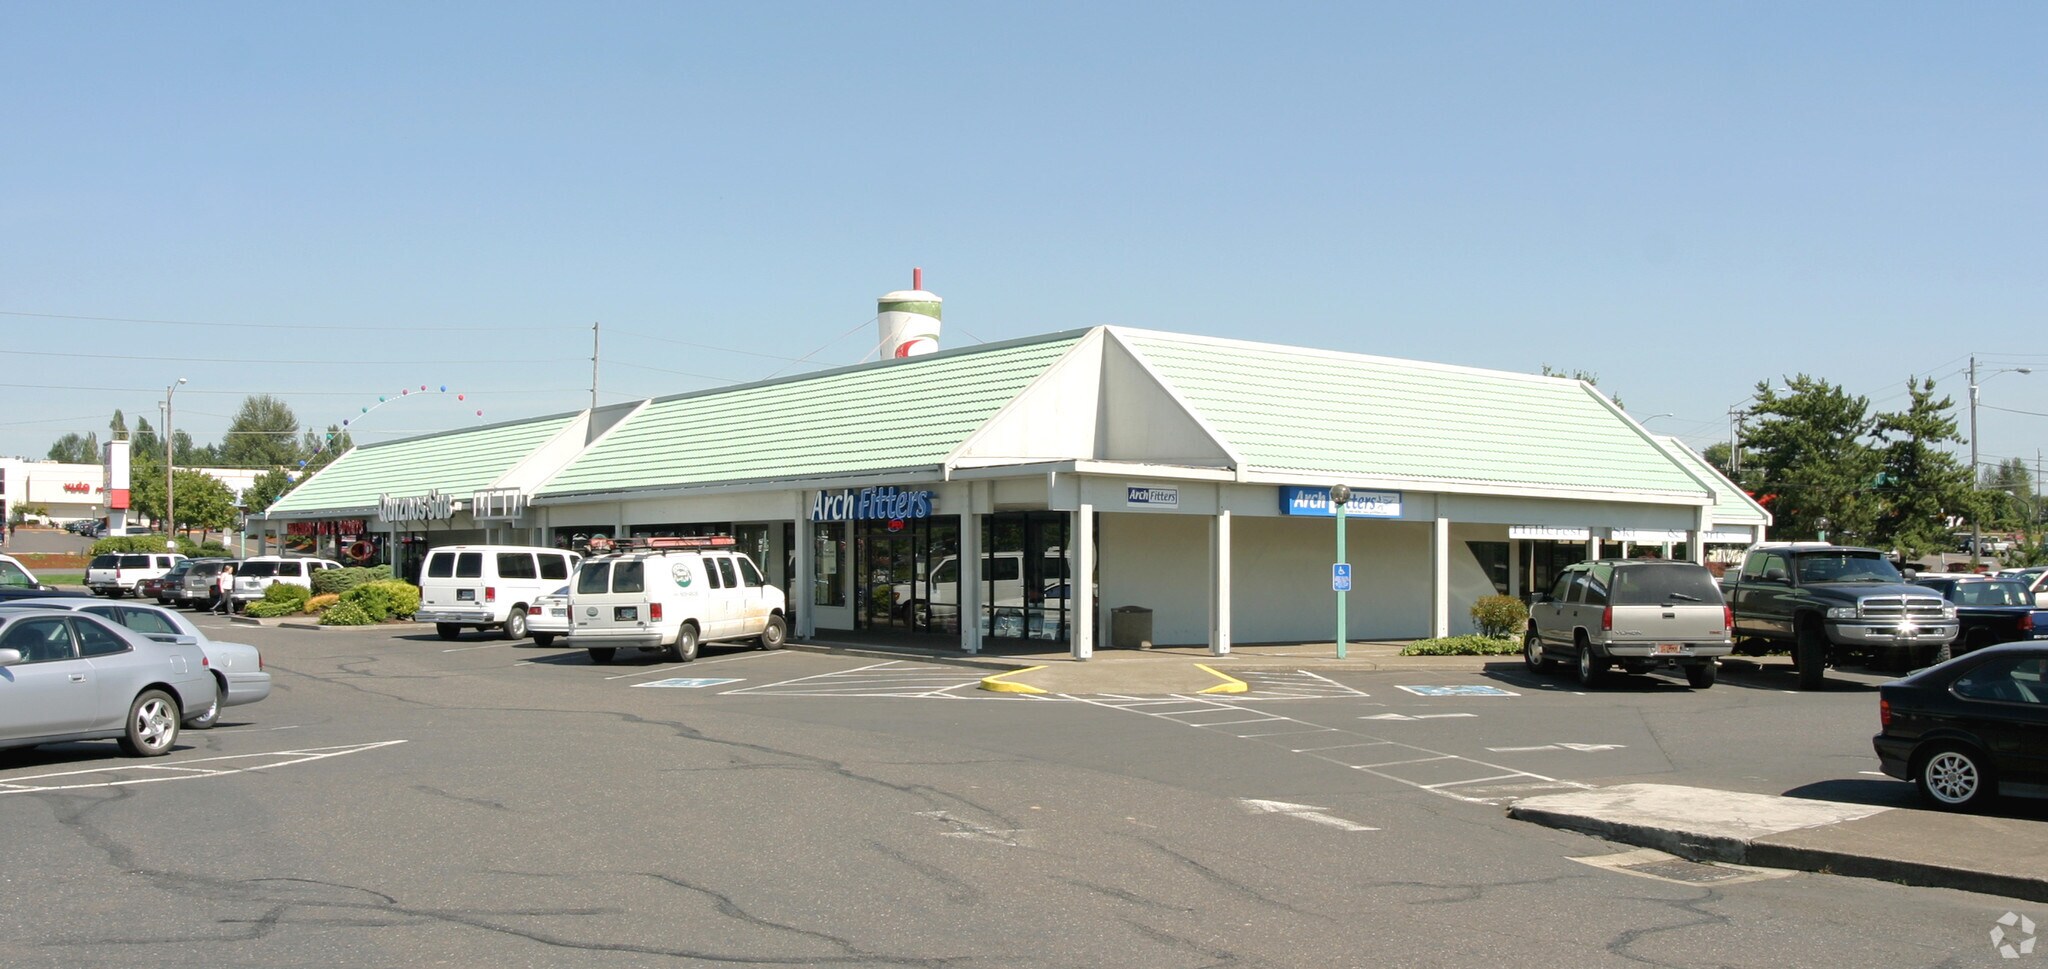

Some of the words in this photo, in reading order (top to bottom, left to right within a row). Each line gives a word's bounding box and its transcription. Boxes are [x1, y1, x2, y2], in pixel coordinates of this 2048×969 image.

[811, 489, 854, 520] Arch
[858, 486, 928, 519] Fitters
[1129, 489, 1149, 500] Arch
[1150, 490, 1176, 501] Fitters
[1294, 490, 1326, 509] Arch
[1335, 493, 1376, 510] tters
